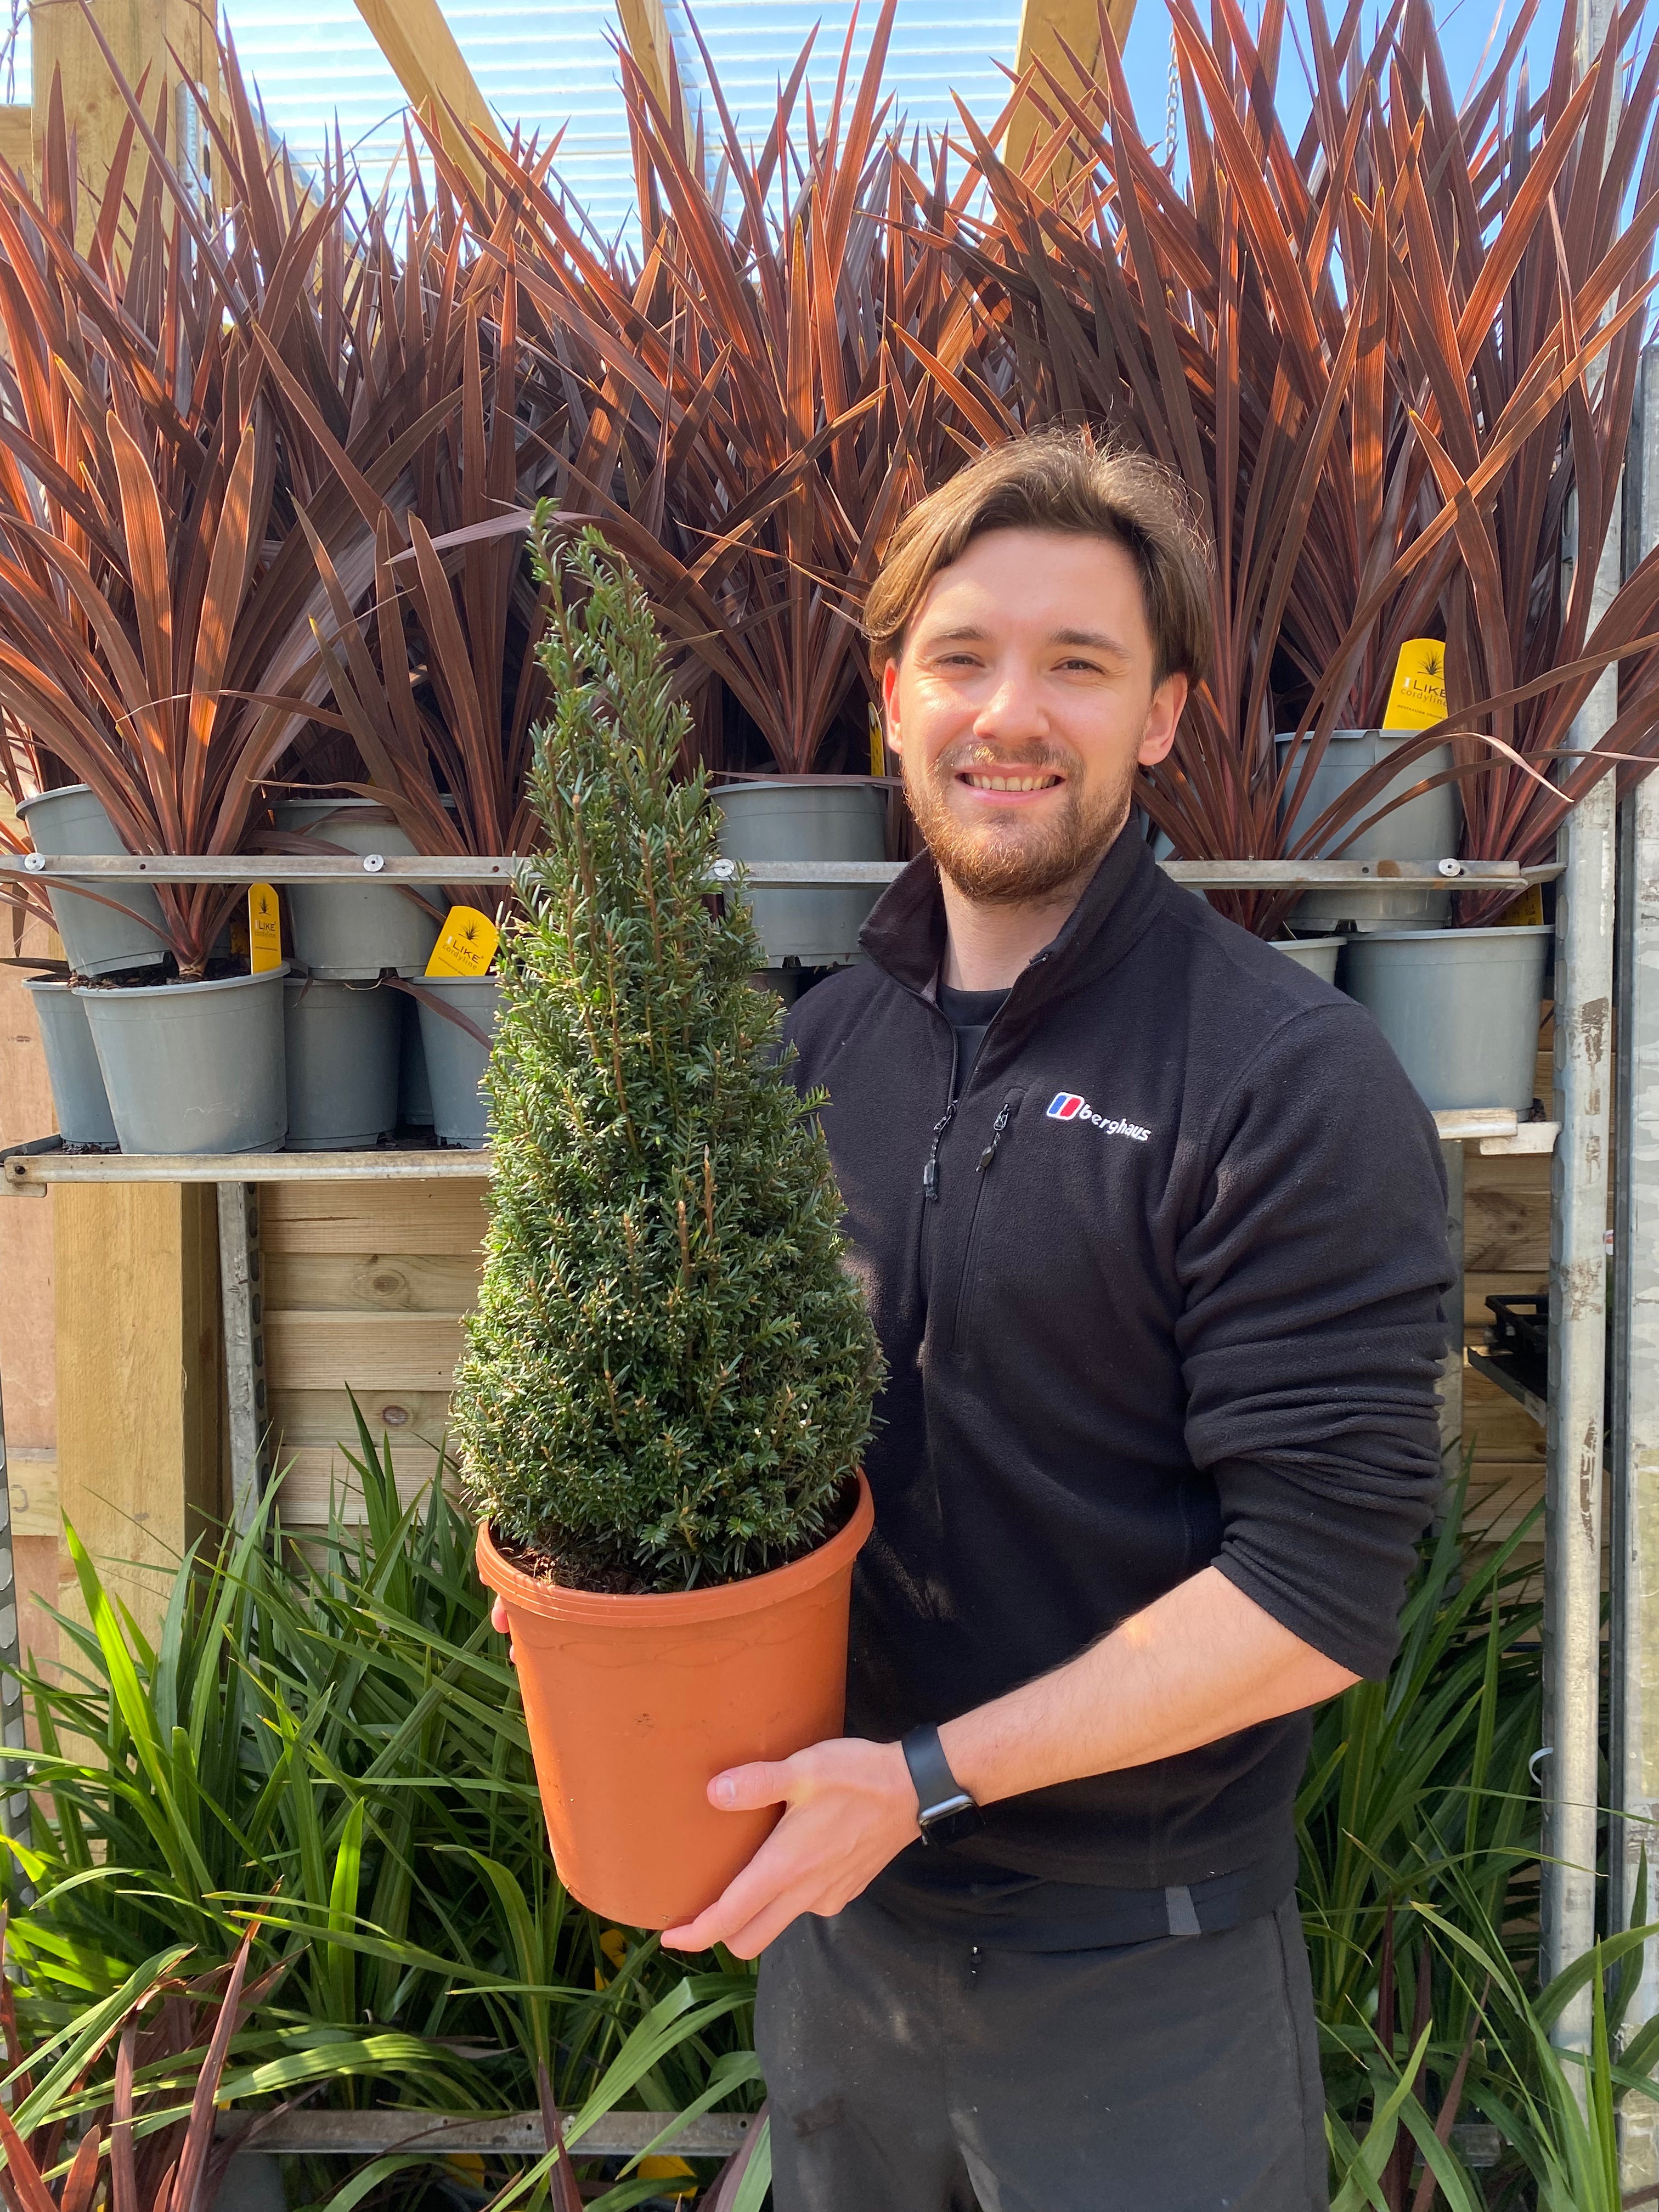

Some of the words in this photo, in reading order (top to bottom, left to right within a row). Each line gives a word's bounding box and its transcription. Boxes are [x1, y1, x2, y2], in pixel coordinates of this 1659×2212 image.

[1401, 689, 1447, 707] cordyline
[1404, 677, 1412, 687] I
[1413, 680, 1446, 698] LIKE
[259, 921, 275, 932] LIKE
[443, 944, 478, 970] cordyline
[453, 940, 481, 964] LIKE
[1079, 1104, 1151, 1141] berghaus
